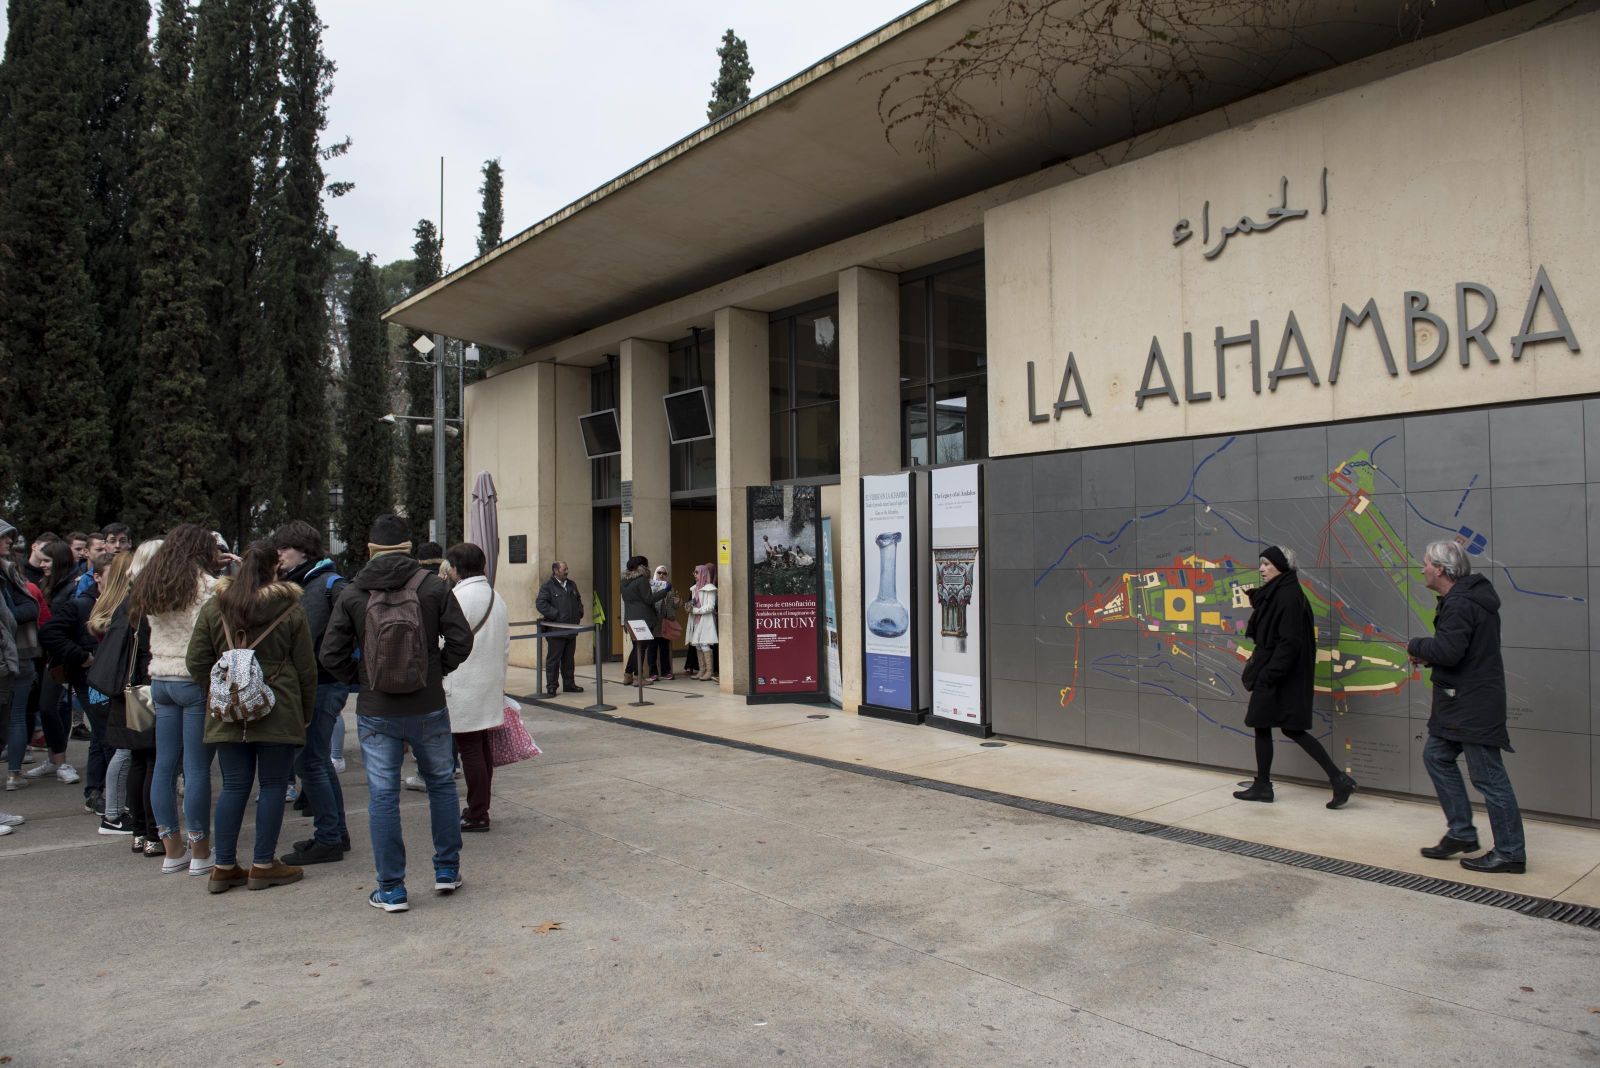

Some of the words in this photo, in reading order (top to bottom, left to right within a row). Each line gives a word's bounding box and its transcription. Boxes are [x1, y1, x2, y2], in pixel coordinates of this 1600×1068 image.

[1173, 167, 1327, 260] الحمراء
[1027, 351, 1092, 422] LA
[1135, 264, 1580, 408] ALHAMBRA
[756, 617, 816, 629] FORTUNY
[781, 600, 816, 608] ensoñación
